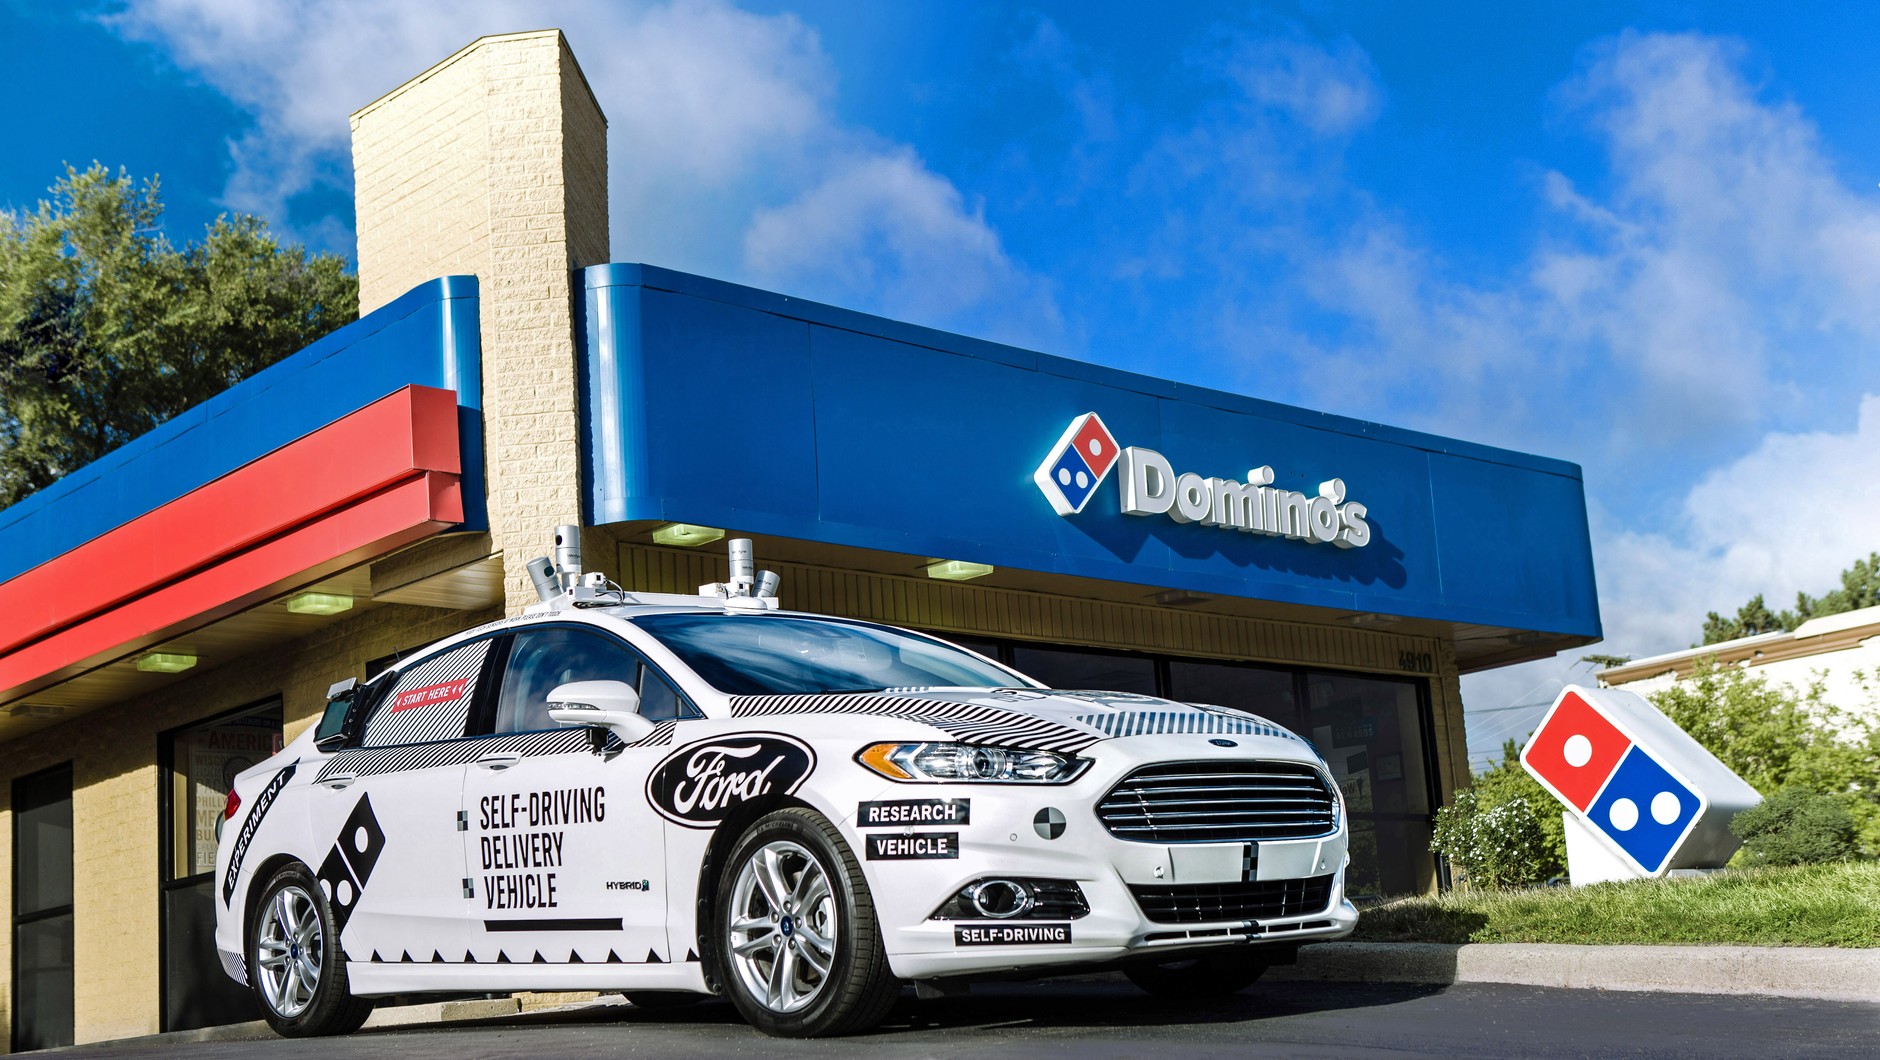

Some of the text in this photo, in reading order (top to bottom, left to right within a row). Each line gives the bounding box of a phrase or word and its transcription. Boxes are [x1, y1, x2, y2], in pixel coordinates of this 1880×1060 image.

[1119, 446, 1371, 549] Domino's
[1399, 651, 1433, 673] 4910
[402, 686, 451, 706] START HERE
[673, 744, 786, 815] Ford
[196, 810, 219, 827] ME
[480, 786, 605, 830] SELF-DRIVING
[868, 804, 956, 823] RESEARCH
[227, 770, 287, 890] EXPERIMENT
[480, 831, 564, 870] DELIVERY
[876, 838, 948, 856] VEHICLE
[483, 873, 558, 910] VEHICLE
[606, 881, 642, 890] HYBRID
[961, 927, 1065, 943] SELF-DRIVING
